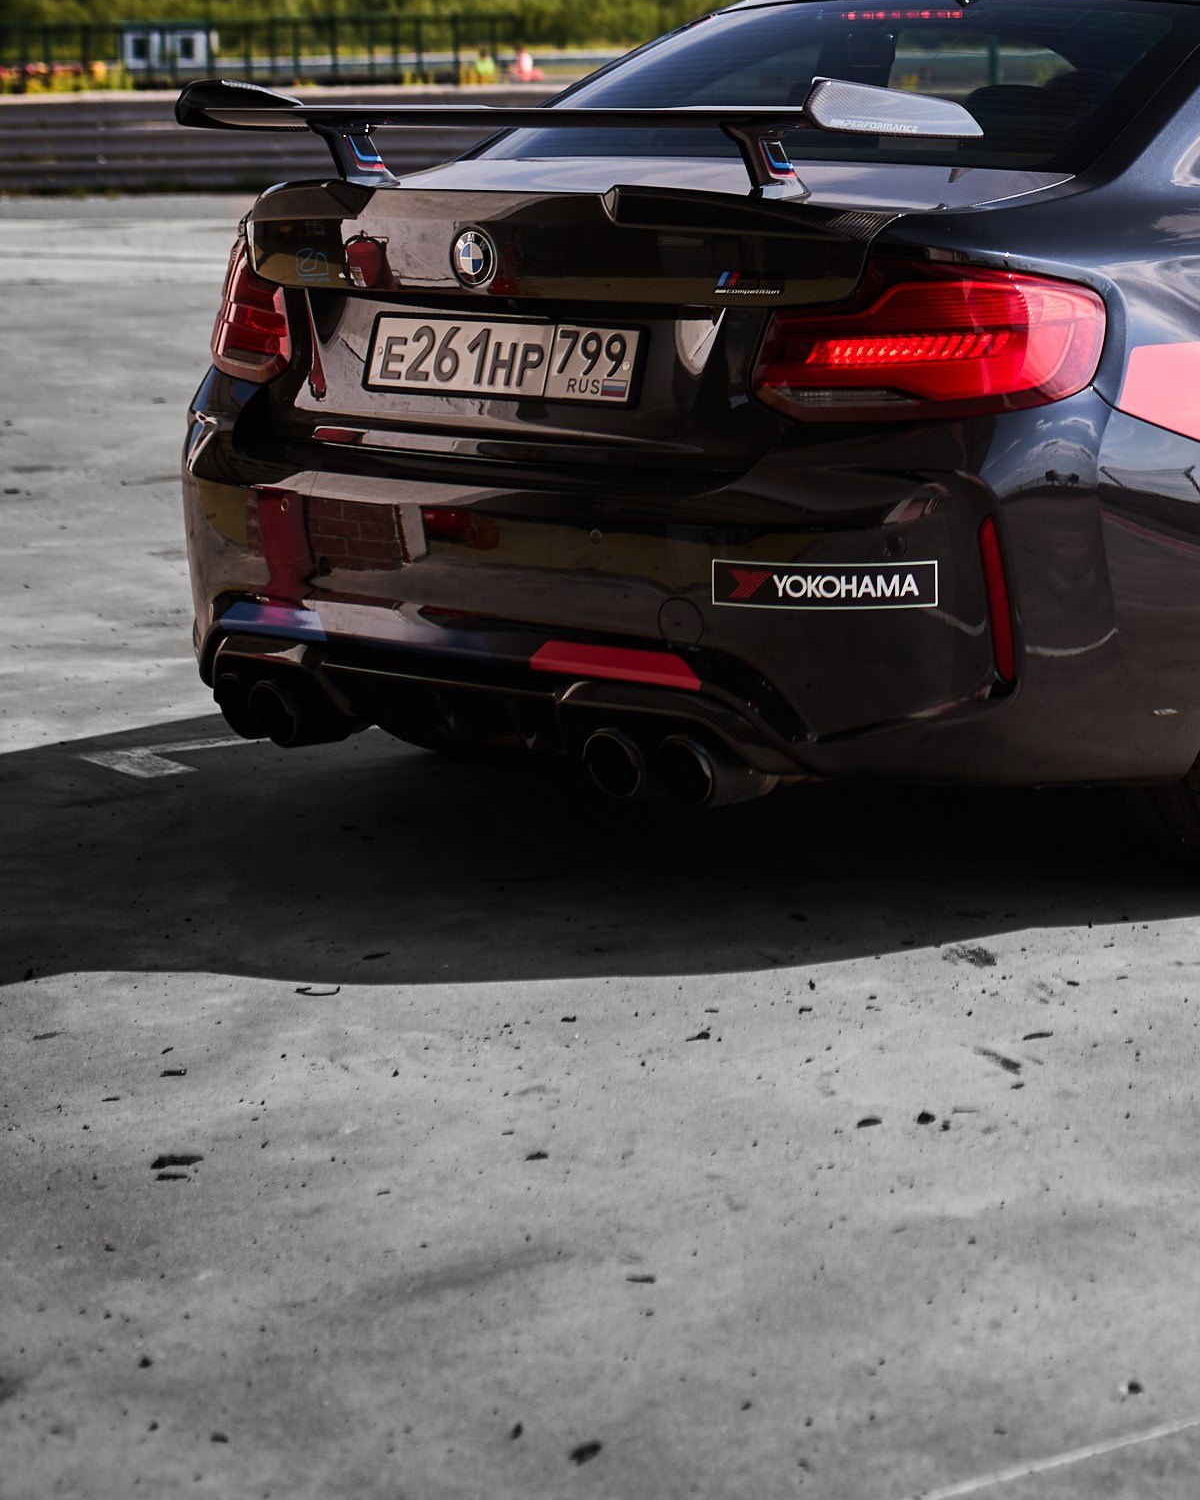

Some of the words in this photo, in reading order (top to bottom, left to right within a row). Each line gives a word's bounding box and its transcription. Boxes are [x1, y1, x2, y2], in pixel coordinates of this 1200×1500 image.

[456, 232, 489, 251] BMW
[556, 329, 627, 378] 799
[566, 378, 600, 394] RUS
[772, 573, 920, 598] YOKOHAMA
